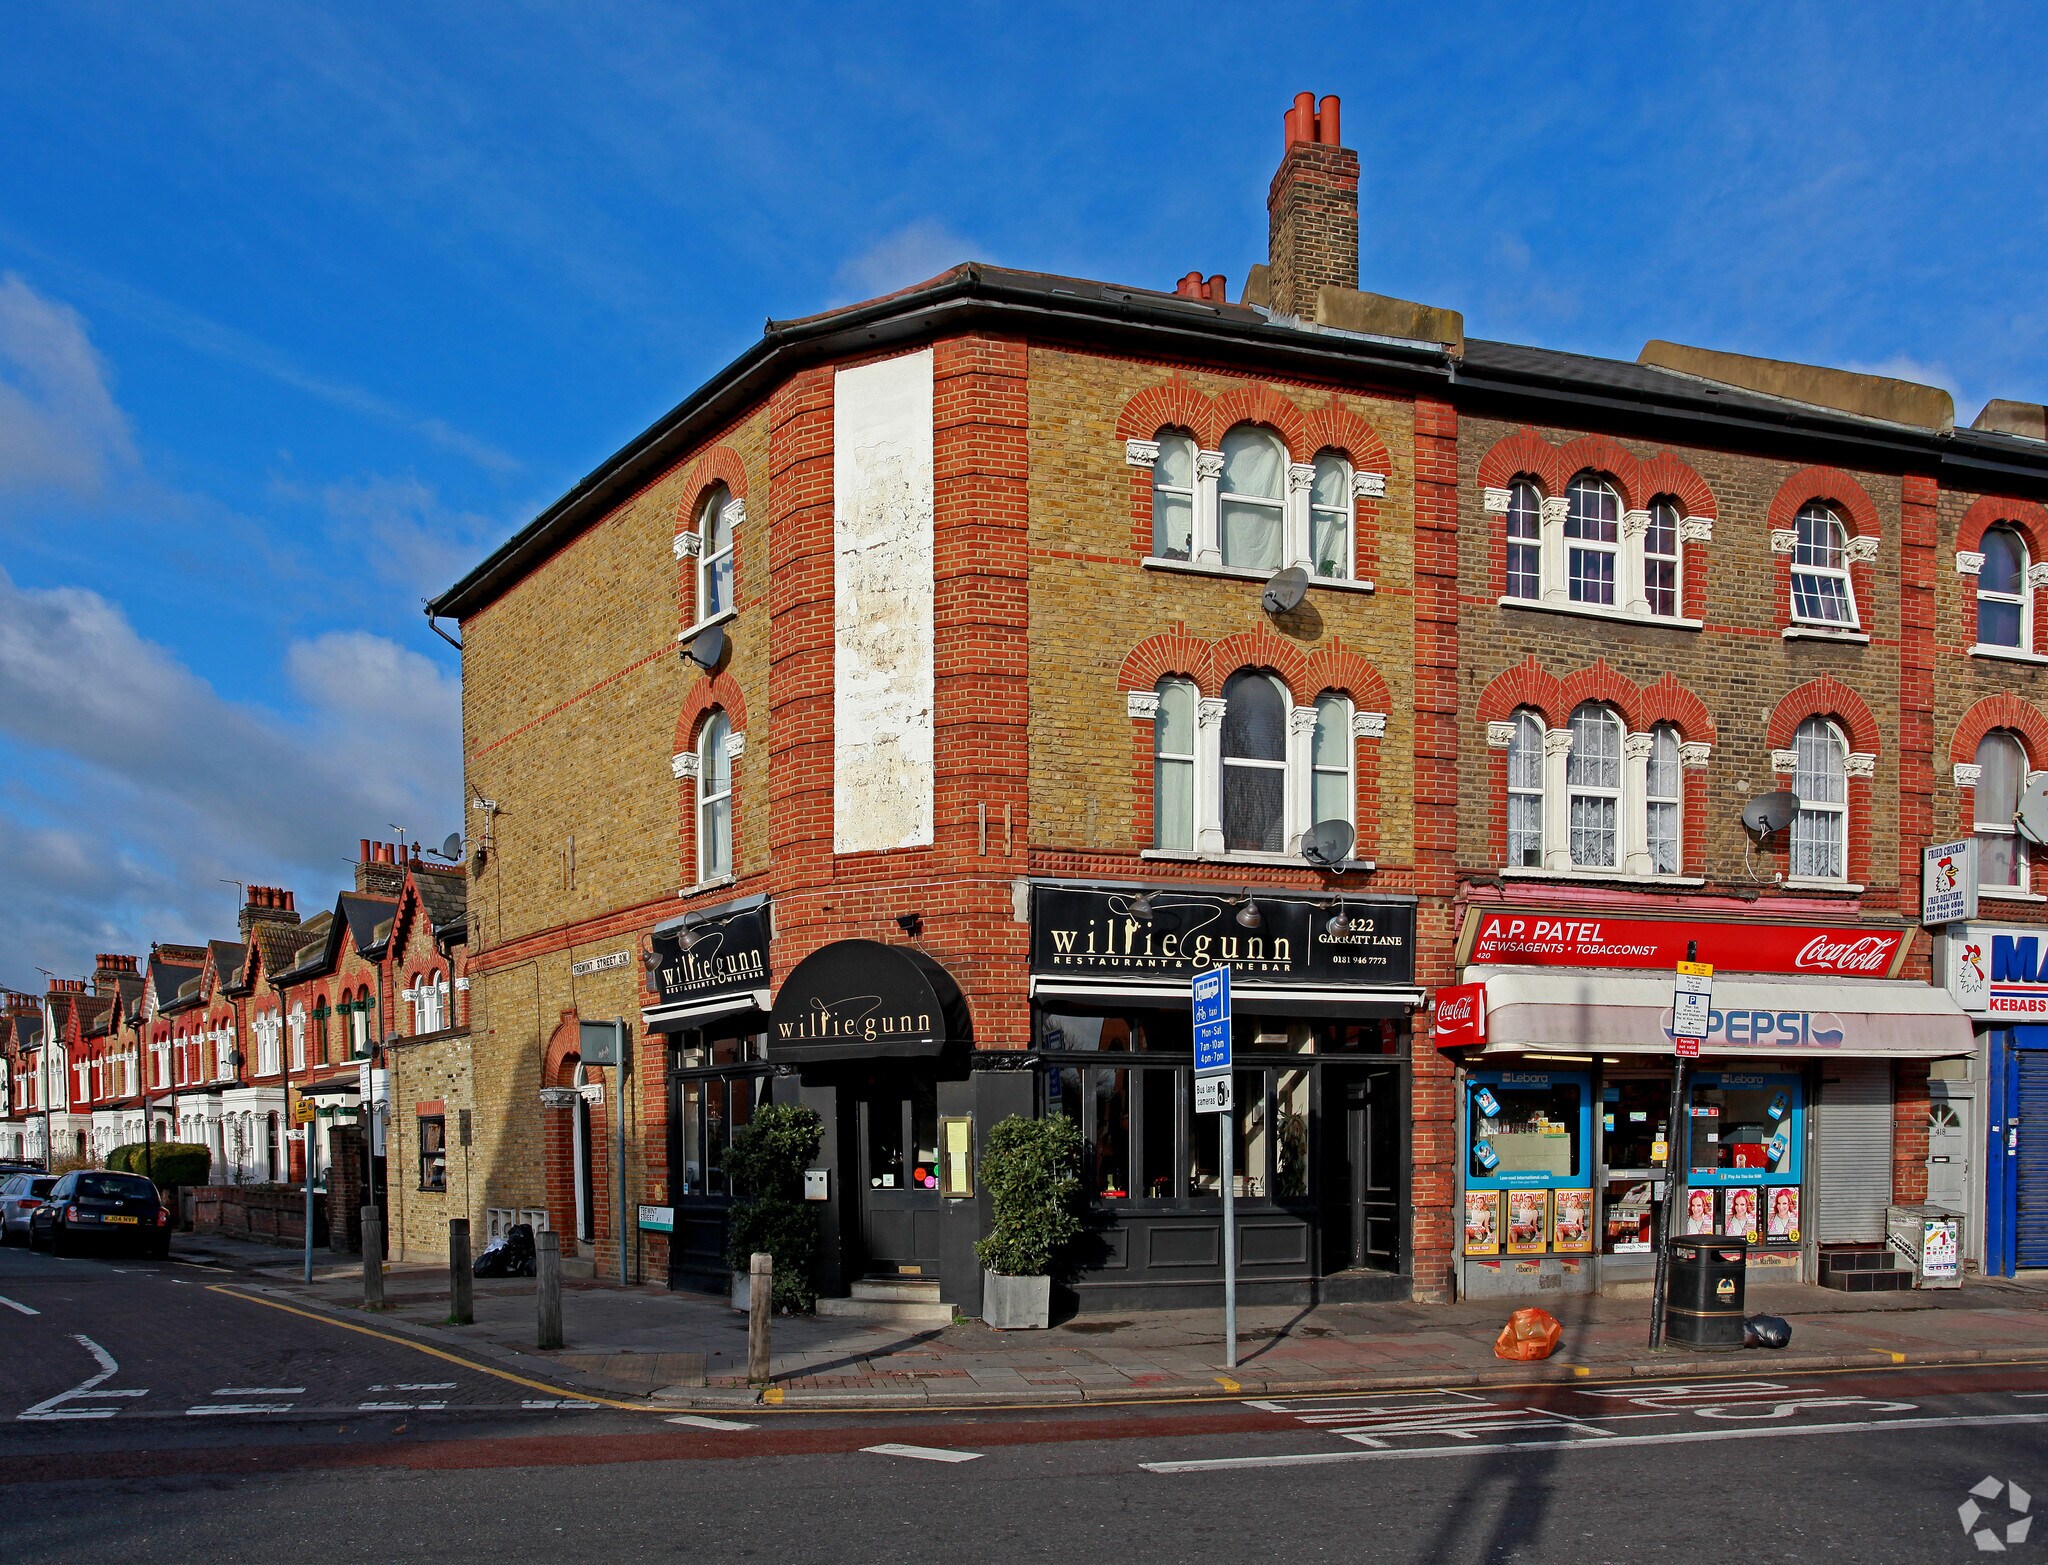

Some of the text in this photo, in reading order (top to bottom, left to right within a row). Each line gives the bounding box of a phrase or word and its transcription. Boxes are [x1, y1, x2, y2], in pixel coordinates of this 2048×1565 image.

[1928, 842, 1966, 860] FRIED CHICKEN
[1928, 891, 1963, 905] FREE DELIVERY
[1349, 918, 1375, 932] 422
[1482, 919, 1604, 942] A.P. PATEL
[1372, 936, 1402, 946] LANE
[1479, 940, 1658, 956] NEWSAGENTS TOBACCONIST
[1192, 934, 1291, 967] gunn
[1476, 951, 1491, 960] 420
[596, 955, 617, 969] STREET
[716, 949, 762, 984] gunn
[1053, 956, 1168, 968] RESTAURANT
[1261, 963, 1291, 972] BAR
[1333, 955, 1387, 965] 0181 946 7773
[666, 982, 710, 995] RESTAURANT
[726, 974, 747, 983] WINE
[748, 970, 765, 980] BAR
[1208, 1006, 1218, 1017] taxi
[1989, 998, 2047, 1013] KEBABS
[864, 1013, 930, 1041] gunn
[1704, 1010, 1809, 1046] PEPSI
[1511, 1072, 1548, 1083] Lebara
[1729, 1074, 1764, 1084] Lebara
[1196, 1084, 1216, 1094] Bus lane
[1197, 1096, 1216, 1106] cameras
[1935, 1127, 1946, 1136] 418
[1790, 1231, 1798, 1239] £2
